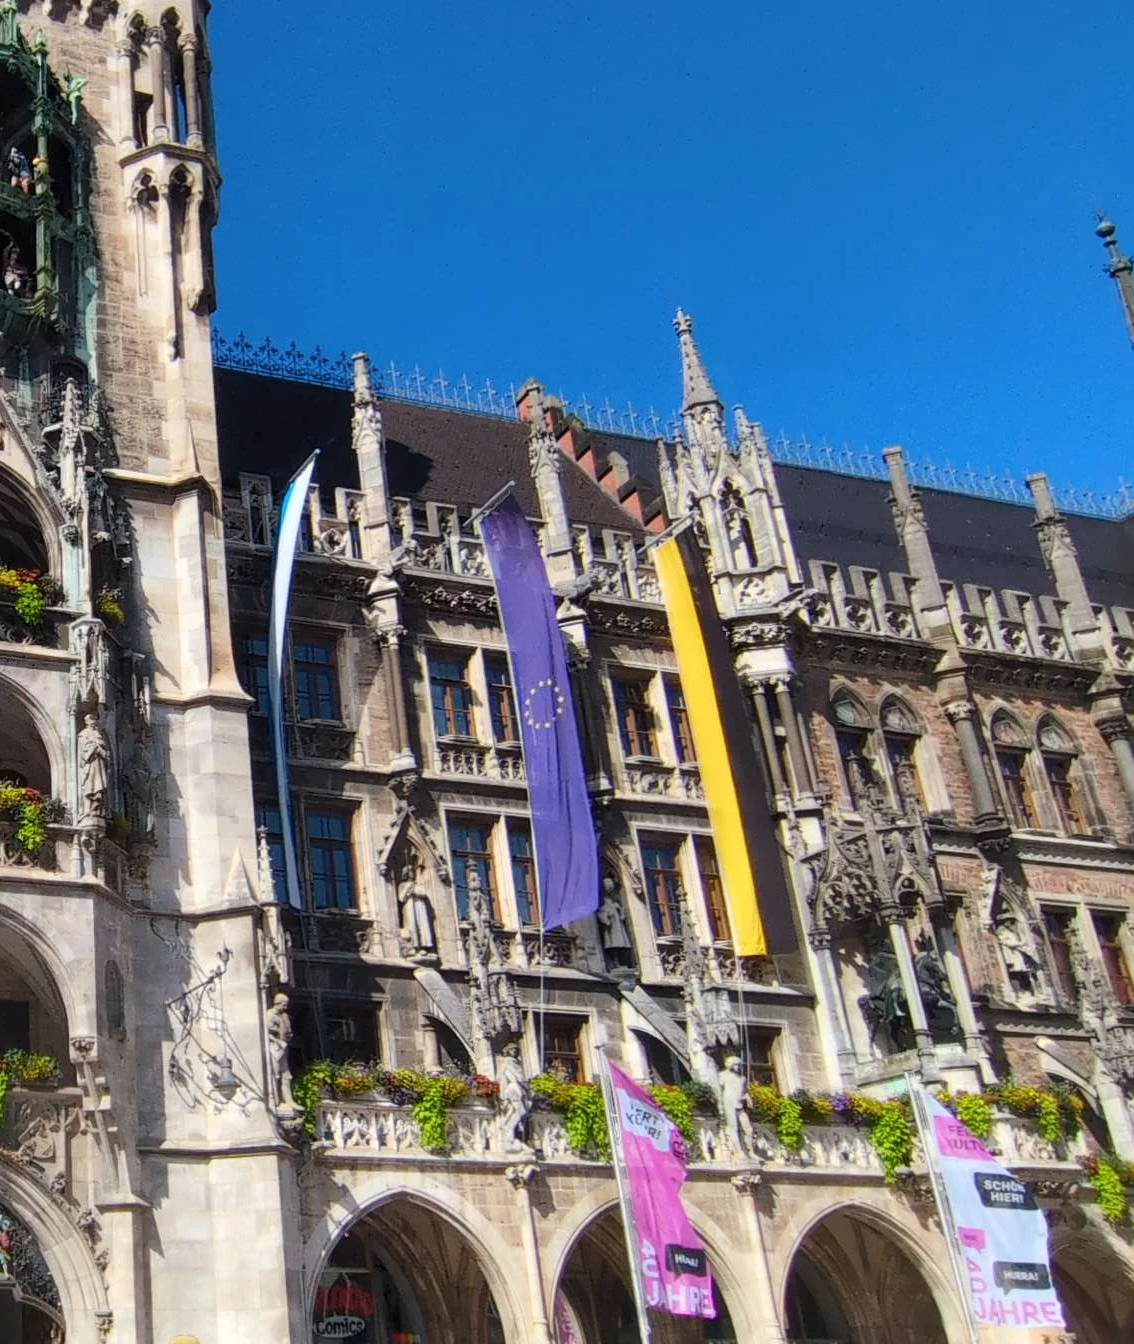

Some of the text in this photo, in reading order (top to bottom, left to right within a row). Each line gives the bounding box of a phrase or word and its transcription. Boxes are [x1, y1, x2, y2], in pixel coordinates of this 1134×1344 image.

[646, 1280, 715, 1317] JHRE
[974, 1297, 1061, 1326] JAHRE
[316, 1317, 364, 1335] Comics
